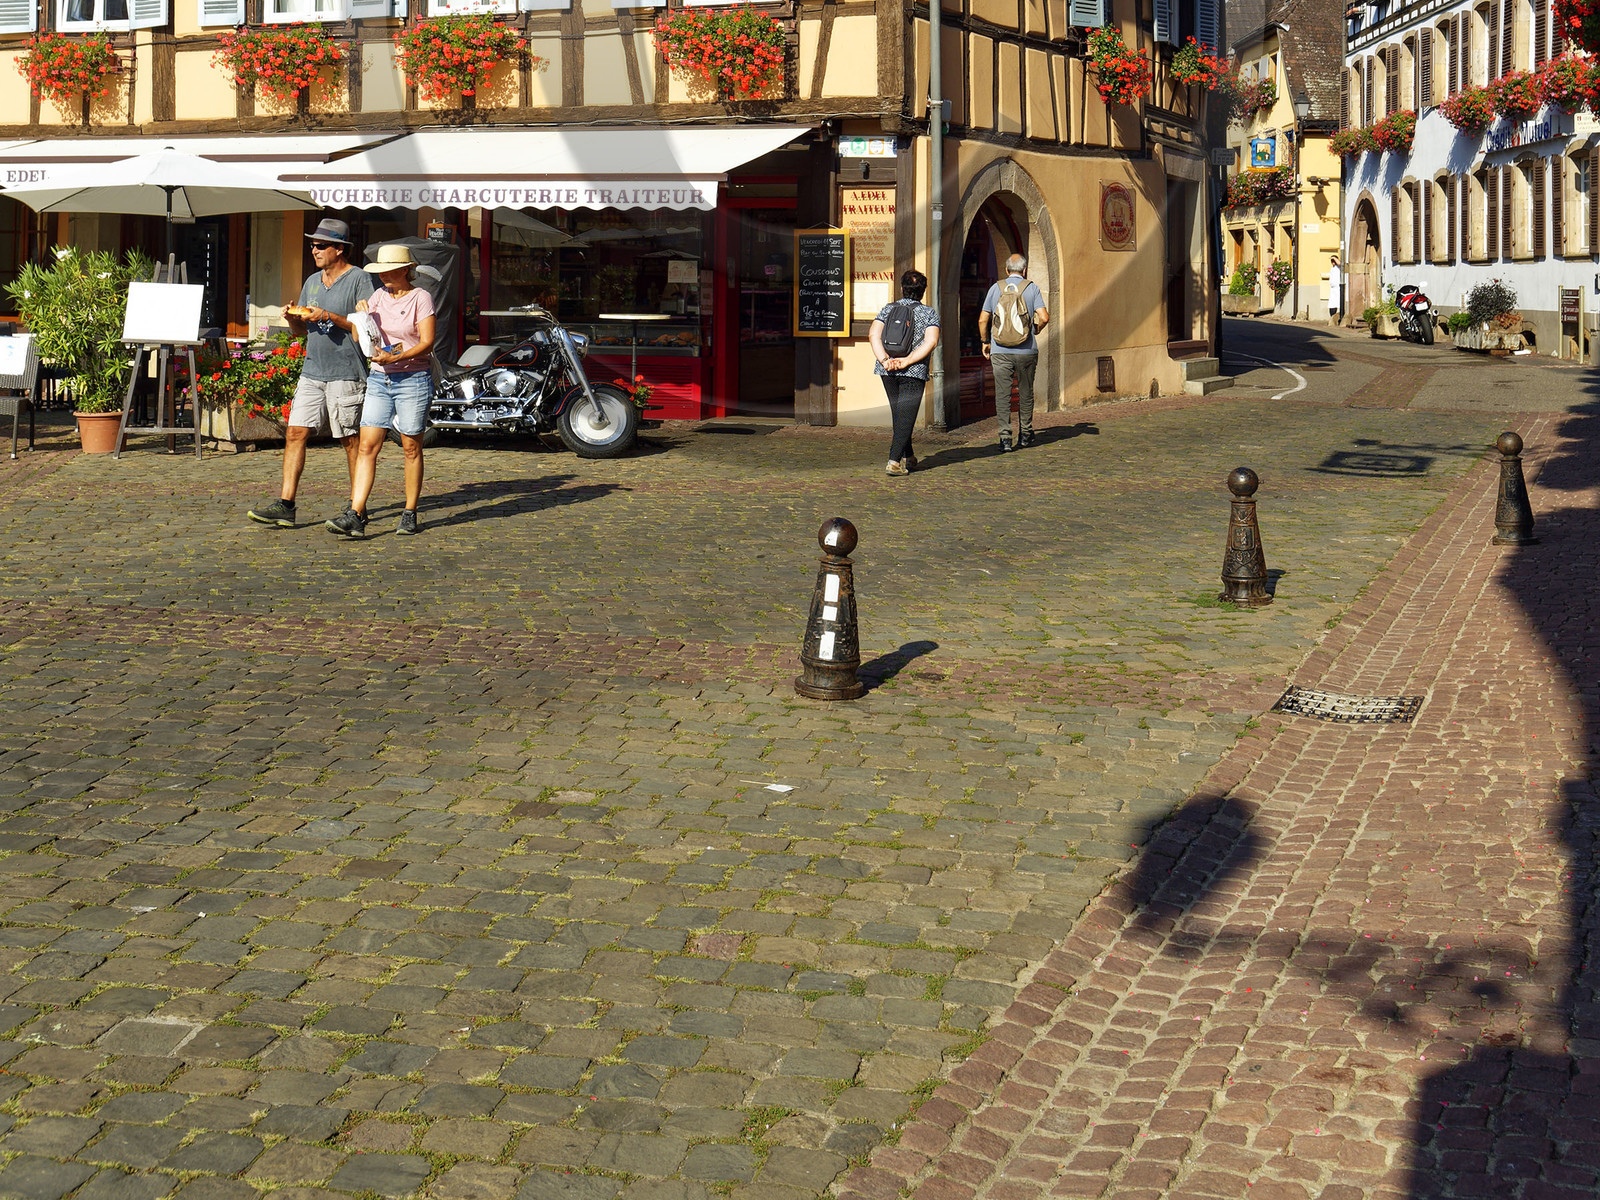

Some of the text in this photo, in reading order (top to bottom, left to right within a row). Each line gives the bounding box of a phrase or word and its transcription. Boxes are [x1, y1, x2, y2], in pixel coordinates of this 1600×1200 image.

[418, 188, 578, 204] CHARCUTERIE
[584, 188, 704, 204] TRAITEUR
[843, 204, 895, 215] TRAITEUR
[852, 271, 895, 281] STAURANT
